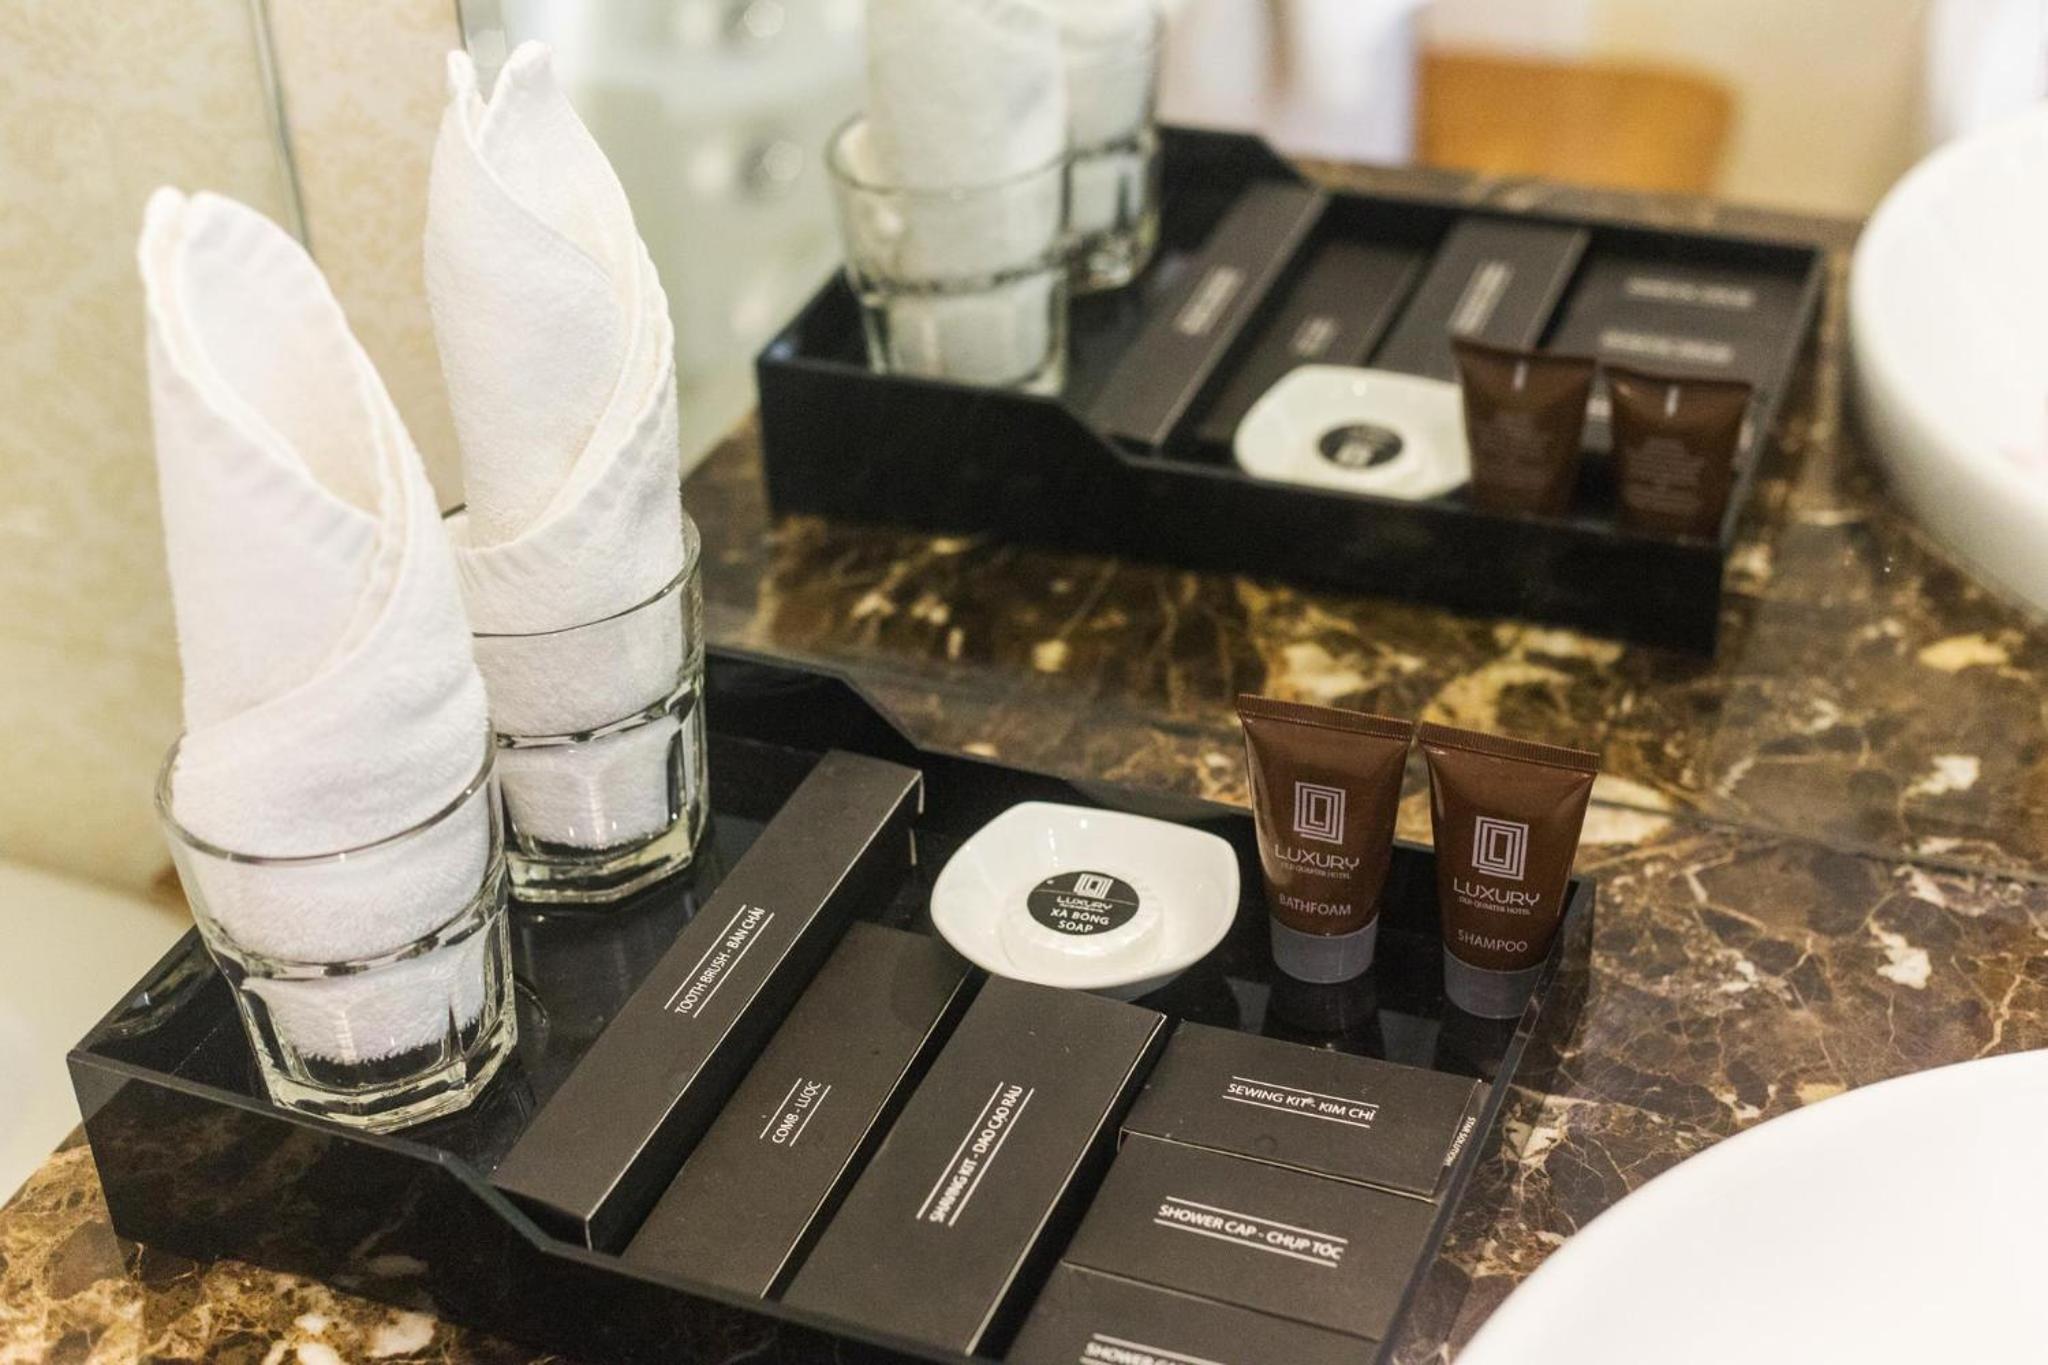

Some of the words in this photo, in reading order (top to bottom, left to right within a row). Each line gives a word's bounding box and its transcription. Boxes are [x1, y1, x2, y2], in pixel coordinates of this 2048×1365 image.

[1274, 844, 1360, 870] LUXURY
[1279, 893, 1352, 916] BATHFOAM
[1453, 877, 1541, 906] LUXURY
[1057, 919, 1094, 933] SOAP
[1458, 929, 1528, 953] SHAMPOO
[674, 982, 708, 1014] TOOTH
[700, 952, 731, 983] BRUSH
[1227, 1083, 1285, 1103] SEWING
[1285, 1095, 1307, 1108] KIT
[1318, 1101, 1346, 1115] KIM
[772, 1113, 799, 1144] COMB
[958, 1157, 978, 1176] KIT
[972, 1128, 996, 1153] DAO
[1158, 1204, 1224, 1229] SHOWER
[1224, 1221, 1257, 1237] CAP
